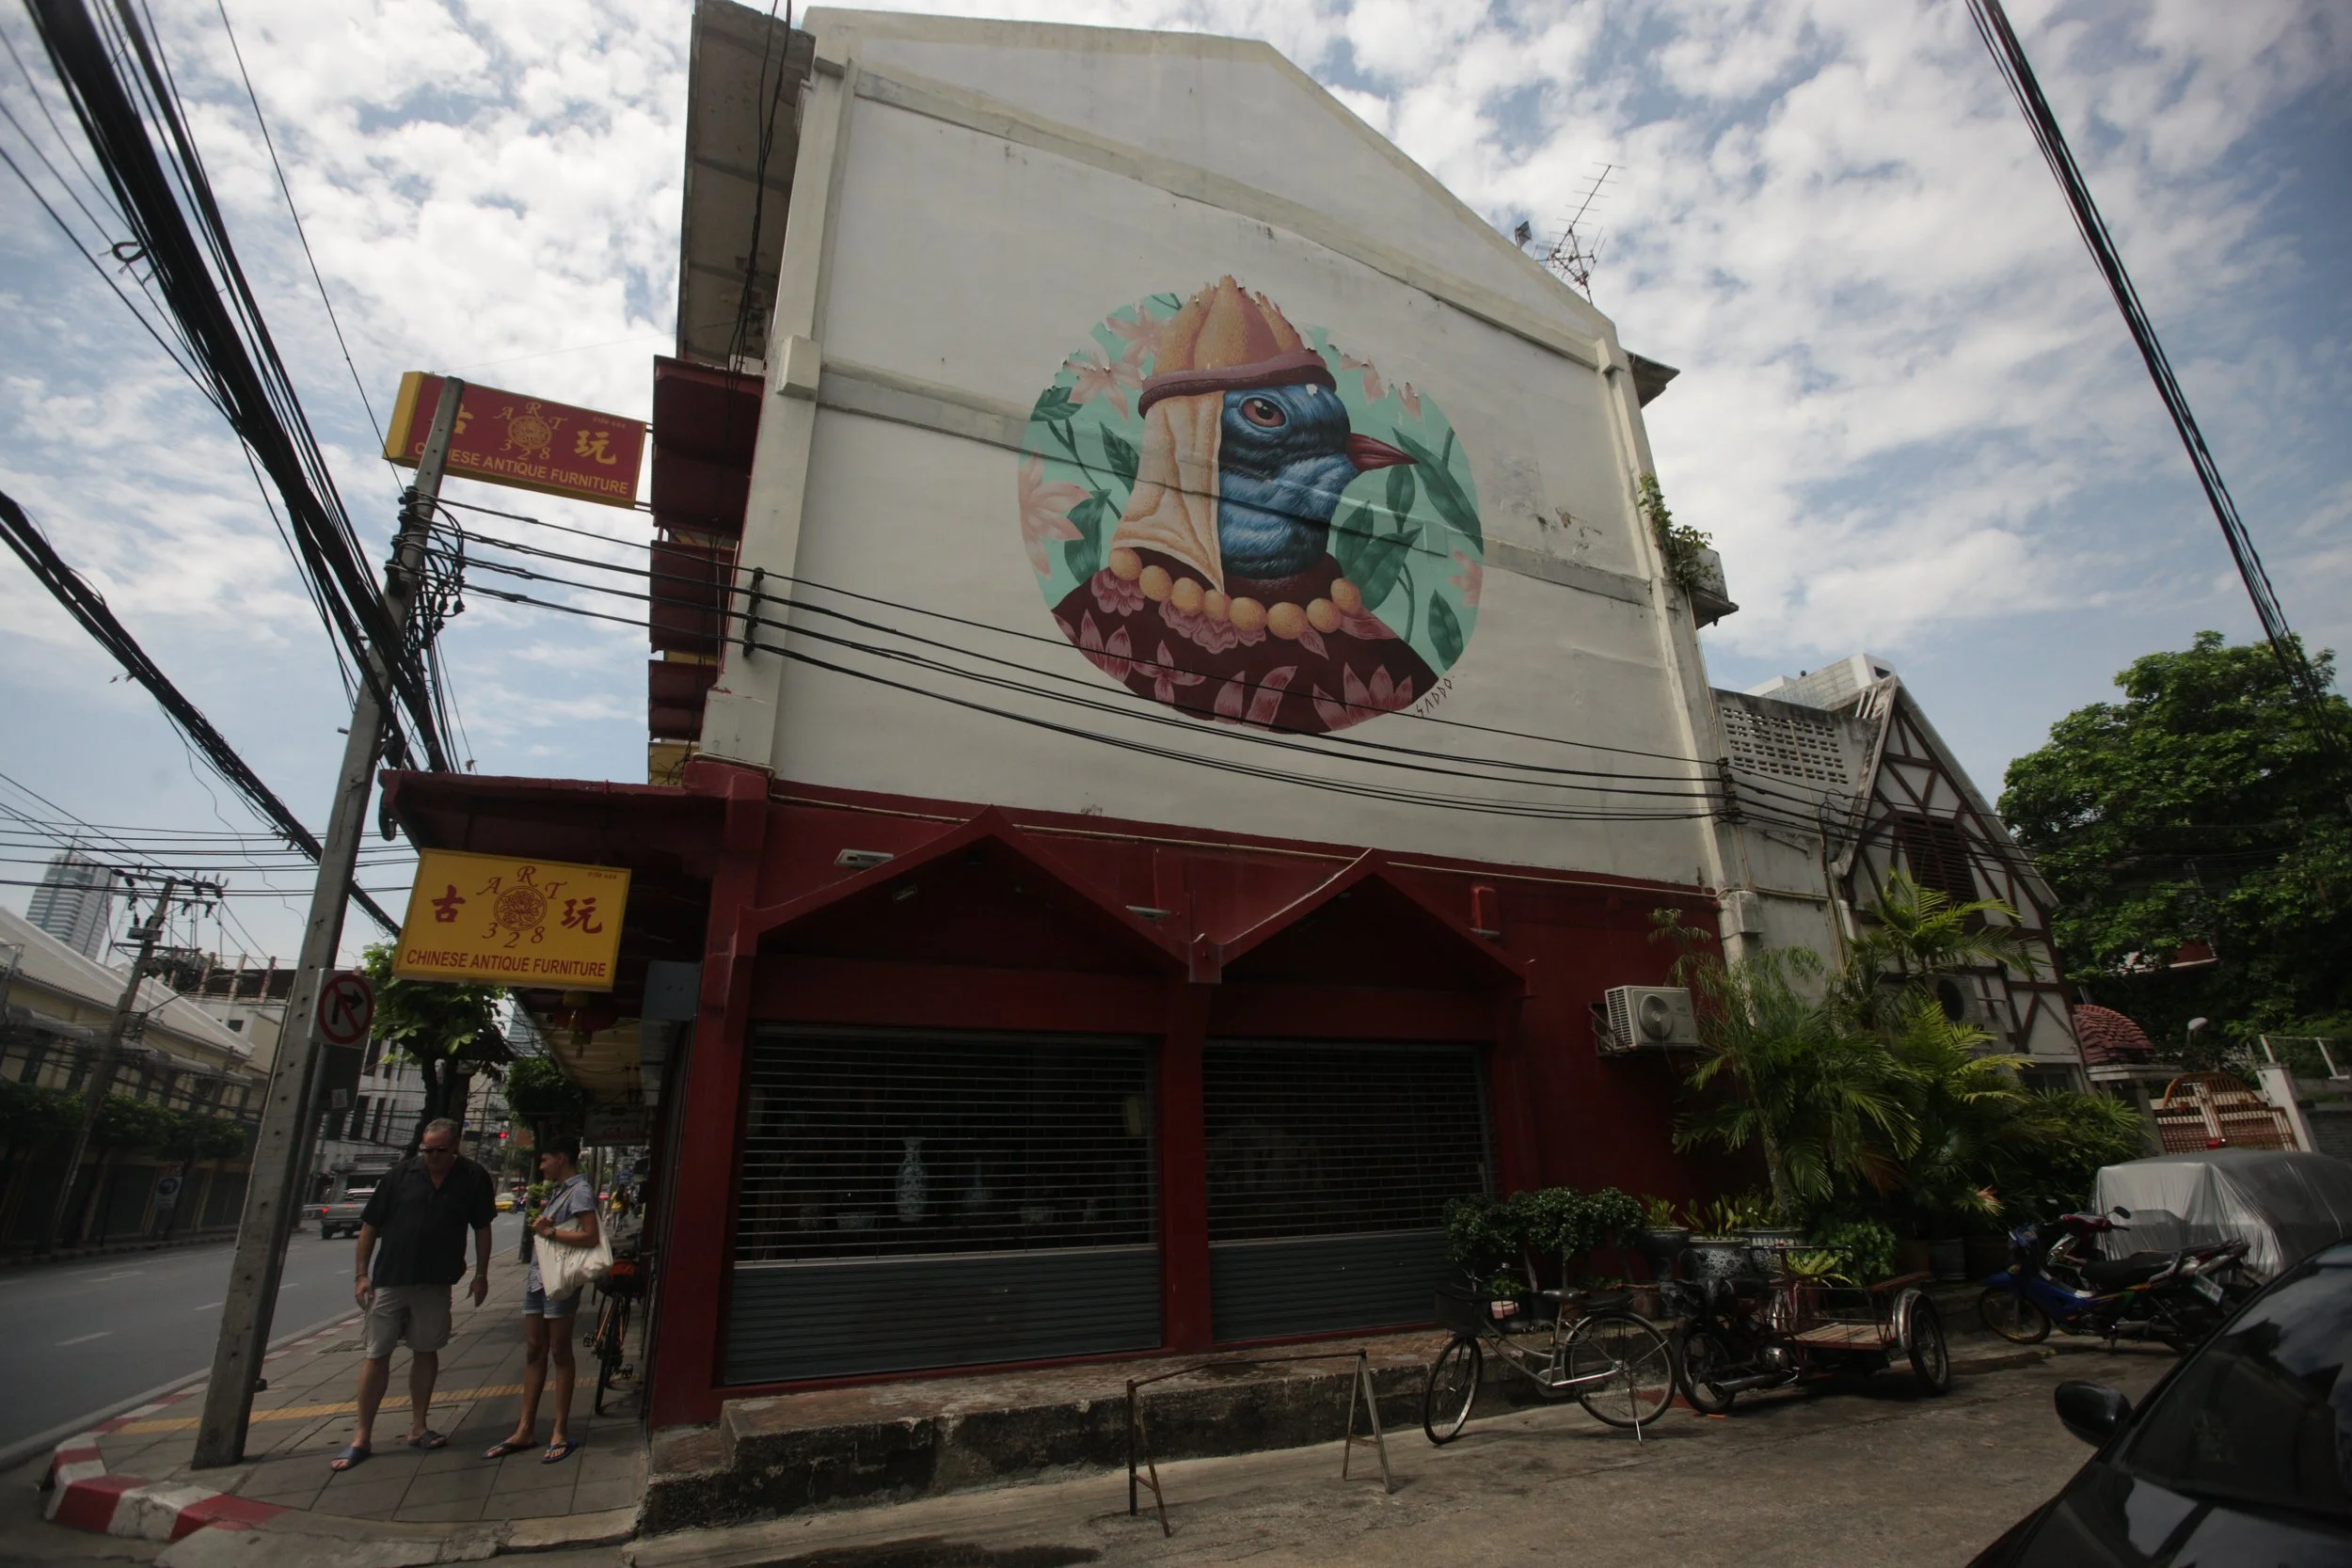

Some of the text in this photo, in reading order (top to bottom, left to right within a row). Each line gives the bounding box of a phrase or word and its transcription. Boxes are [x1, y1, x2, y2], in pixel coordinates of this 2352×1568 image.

[493, 402, 567, 430] ART
[500, 439, 550, 461] 328
[574, 429, 616, 465] 玩
[483, 455, 548, 479] ANTIQUE
[550, 468, 628, 494] FURNITURE
[476, 865, 567, 900] ART
[431, 884, 602, 934] 古 玩
[482, 922, 546, 949] 328
[406, 949, 607, 977] CHINESE ANTIQUE FURNITURE
